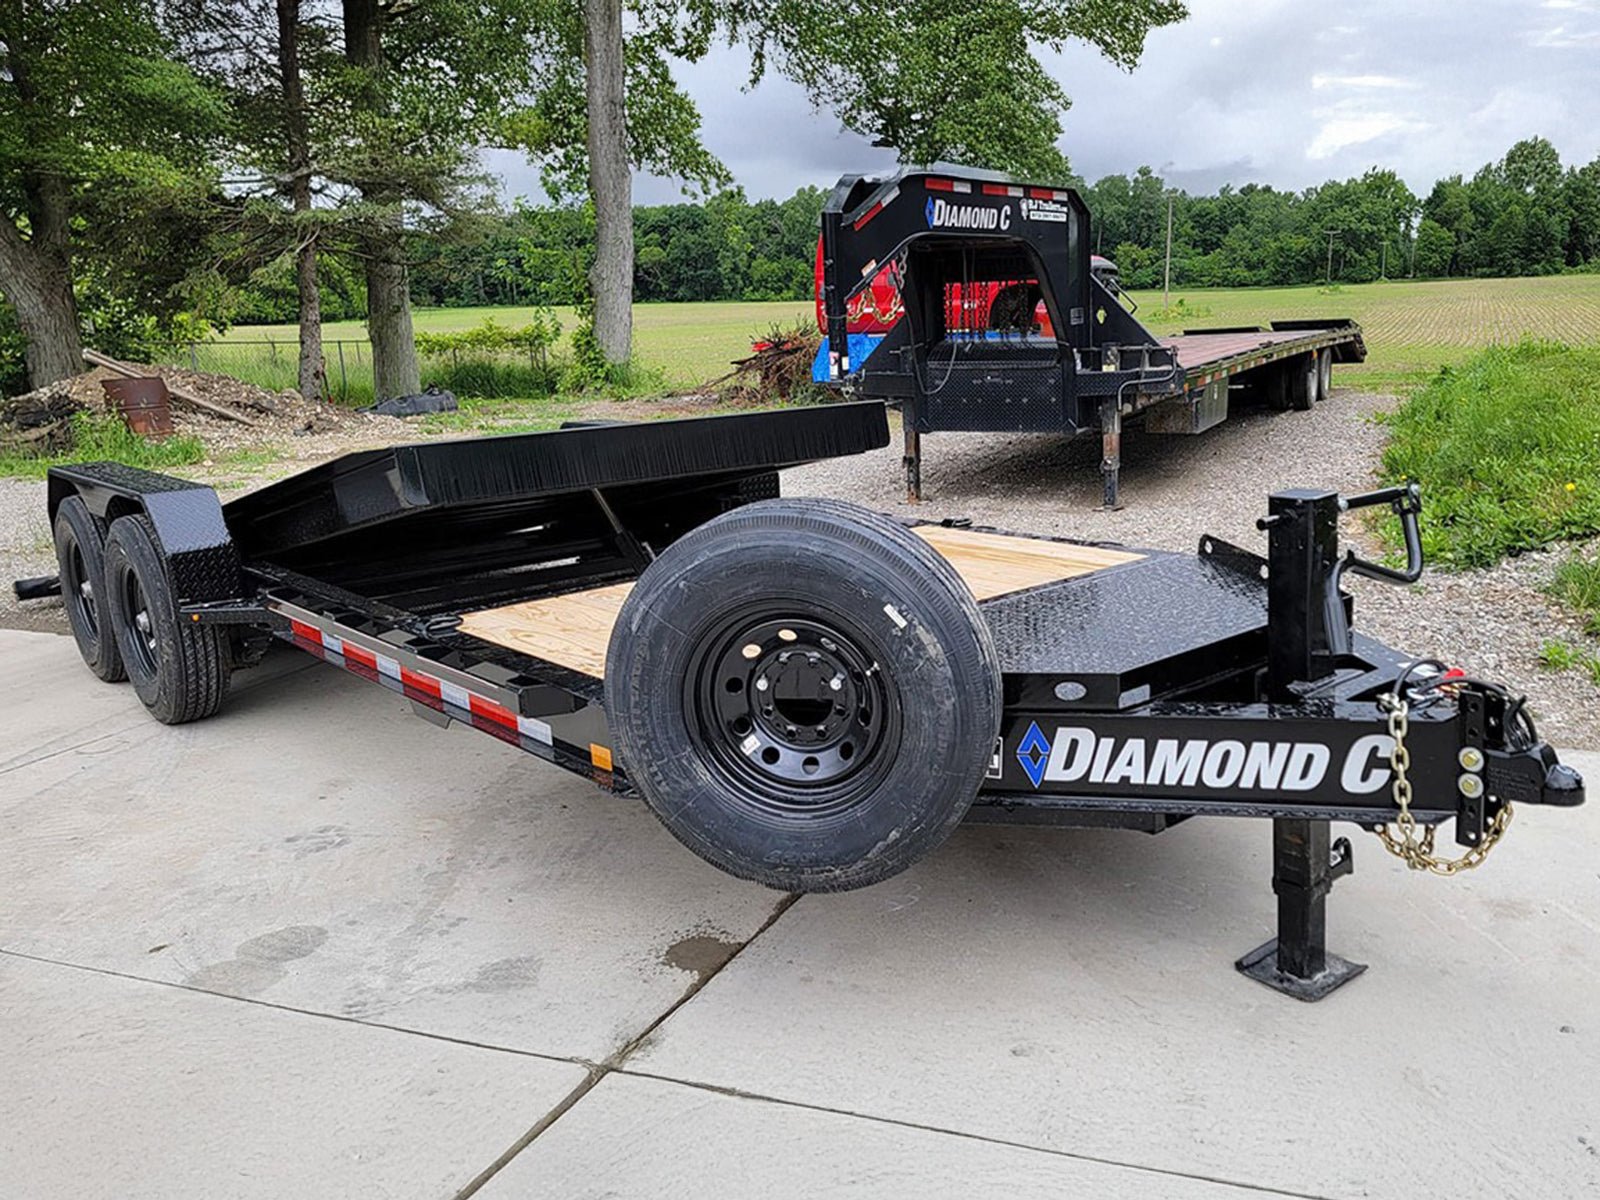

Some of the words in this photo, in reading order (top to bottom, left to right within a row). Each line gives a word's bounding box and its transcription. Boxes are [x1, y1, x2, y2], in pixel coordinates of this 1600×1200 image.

[933, 199, 998, 230] DIAMOND
[1000, 204, 1011, 231] C
[1043, 726, 1331, 792] DIAMOND
[1341, 733, 1397, 794] C
